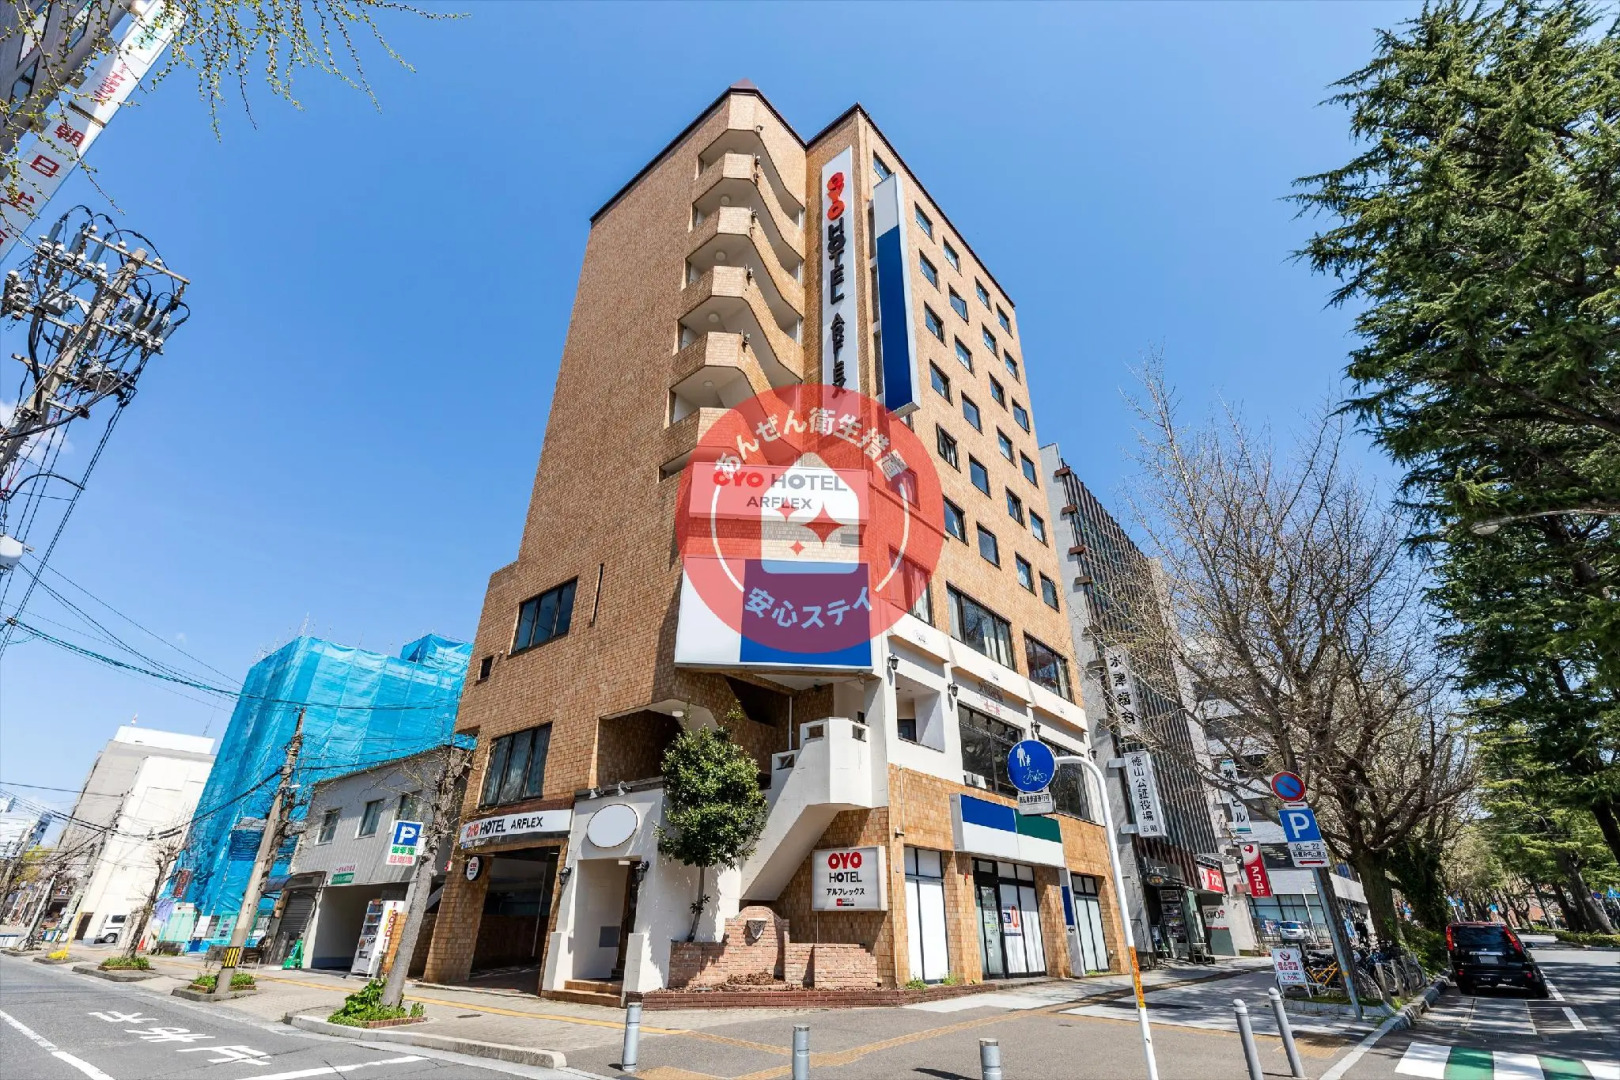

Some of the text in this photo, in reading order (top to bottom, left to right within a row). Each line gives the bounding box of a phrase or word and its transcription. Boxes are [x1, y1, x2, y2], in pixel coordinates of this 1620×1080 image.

[827, 172, 845, 220] OYO
[827, 218, 844, 305] HOTEL
[713, 471, 848, 491] OYO HOTEL
[746, 495, 813, 510] ARFLEX
[1131, 756, 1155, 821] 徳山公証役場
[398, 825, 416, 844] P
[479, 818, 506, 835] HOTEL
[510, 816, 543, 830] ARFLEX
[1288, 812, 1310, 838] P
[828, 852, 862, 869] OYO
[829, 872, 862, 883] HOTEL
[826, 888, 865, 896] アルフレックス
